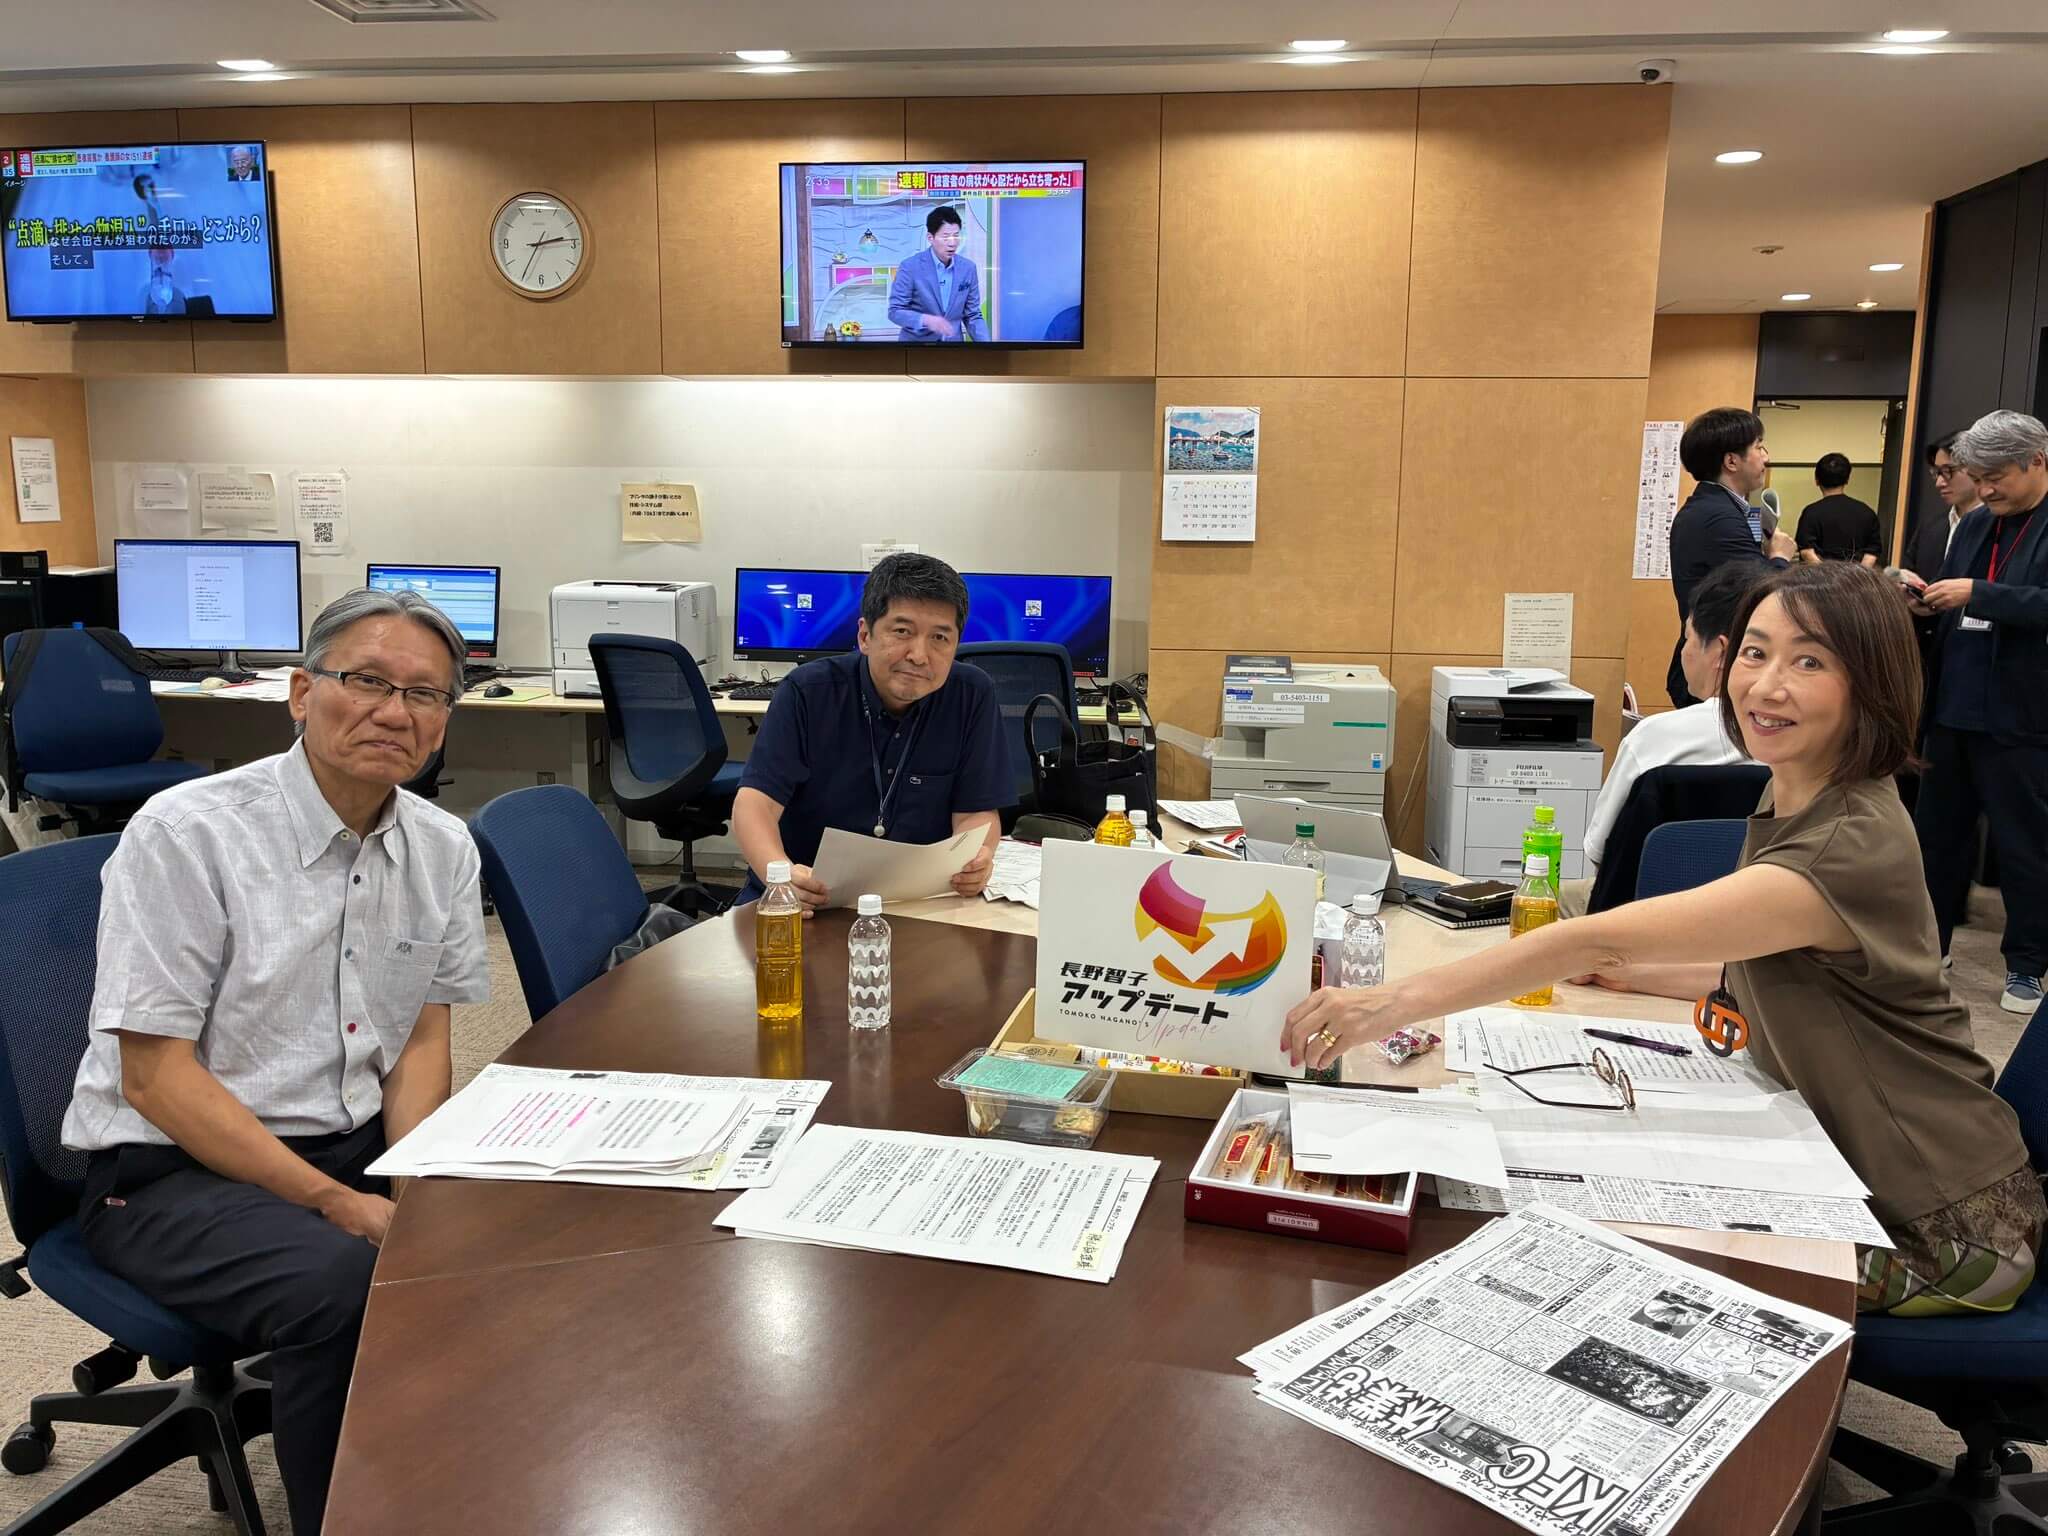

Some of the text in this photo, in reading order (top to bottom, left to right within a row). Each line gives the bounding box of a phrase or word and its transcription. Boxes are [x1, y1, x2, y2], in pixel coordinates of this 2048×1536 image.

[897, 172, 926, 189] 速報
[51, 254, 90, 266] そして。
[1280, 694, 1324, 702] 03-5403-1151
[1060, 962, 1149, 986] 長野智子
[1059, 1008, 1096, 1020] TOMOKO
[1060, 982, 1229, 1025] アップデート
[1136, 1003, 1224, 1047] Update
[1314, 1365, 1456, 1442] 休業も
[1440, 1441, 1468, 1459] KFC
[1485, 1445, 1630, 1533] KFC
